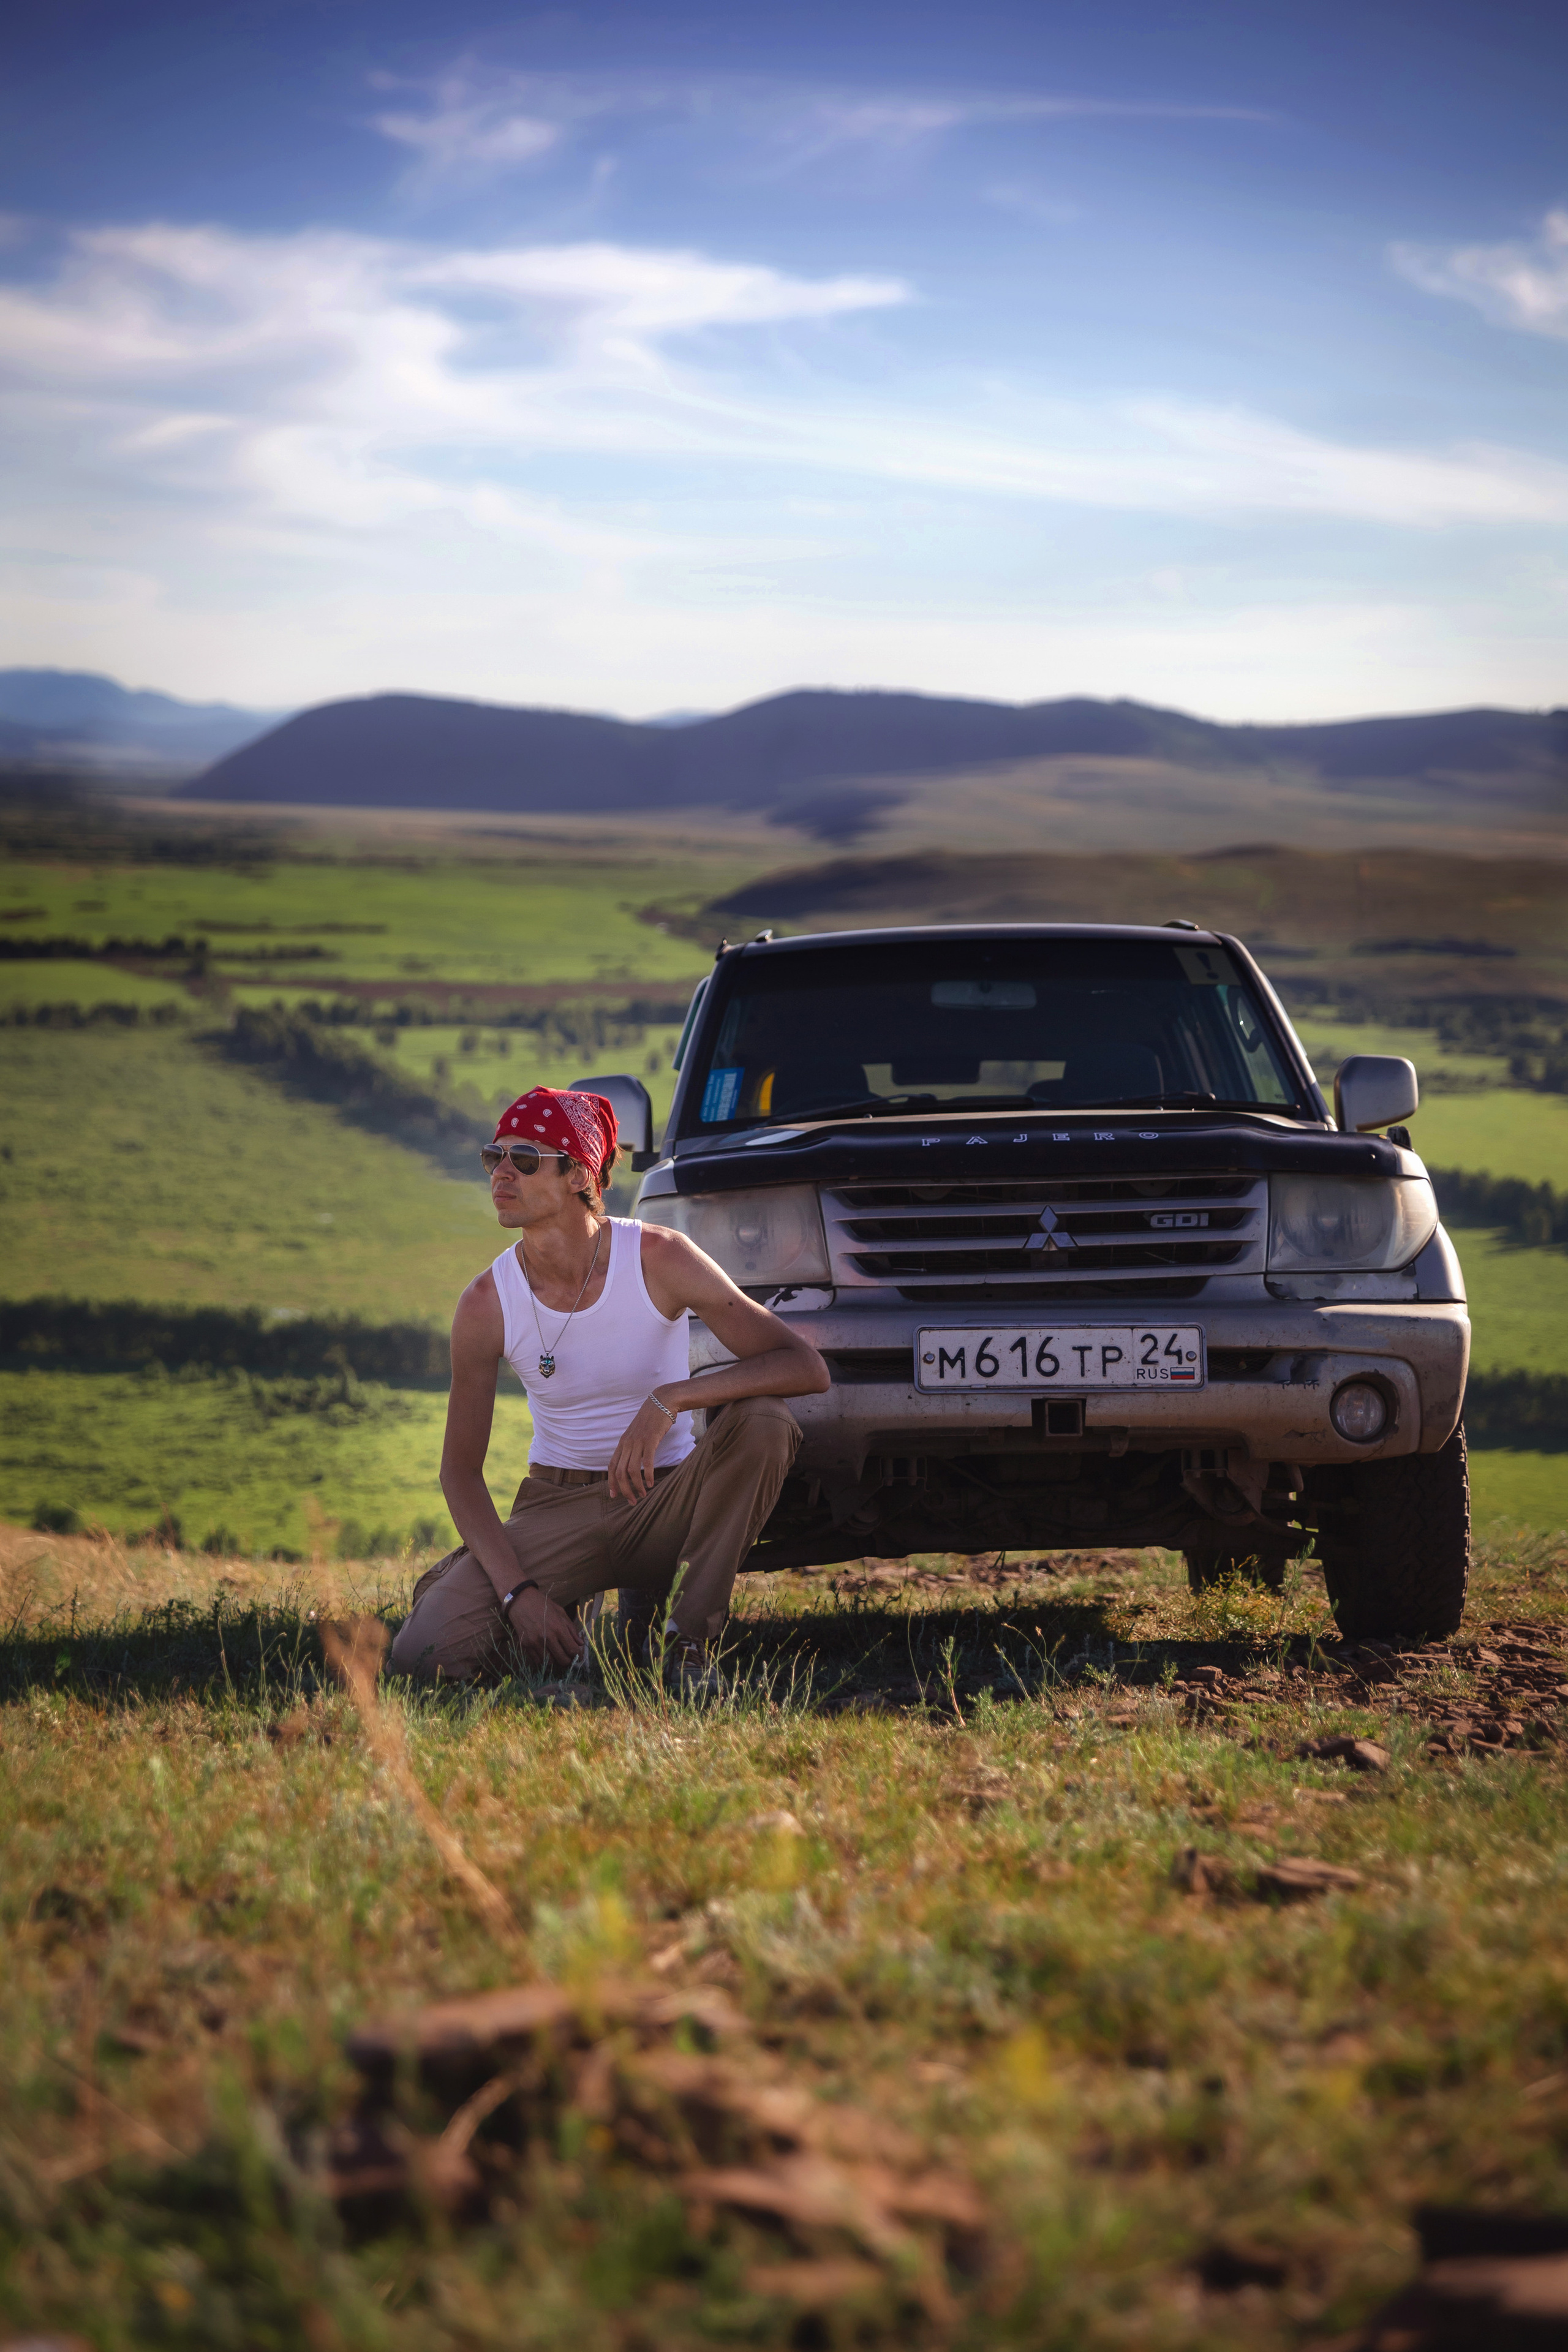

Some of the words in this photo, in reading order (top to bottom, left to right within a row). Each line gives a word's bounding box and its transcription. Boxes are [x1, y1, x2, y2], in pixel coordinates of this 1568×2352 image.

[922, 1132, 1159, 1146] PAJERO
[1150, 1213, 1209, 1228] GDI
[1140, 1333, 1183, 1365] 24
[1136, 1368, 1169, 1380] RUS
